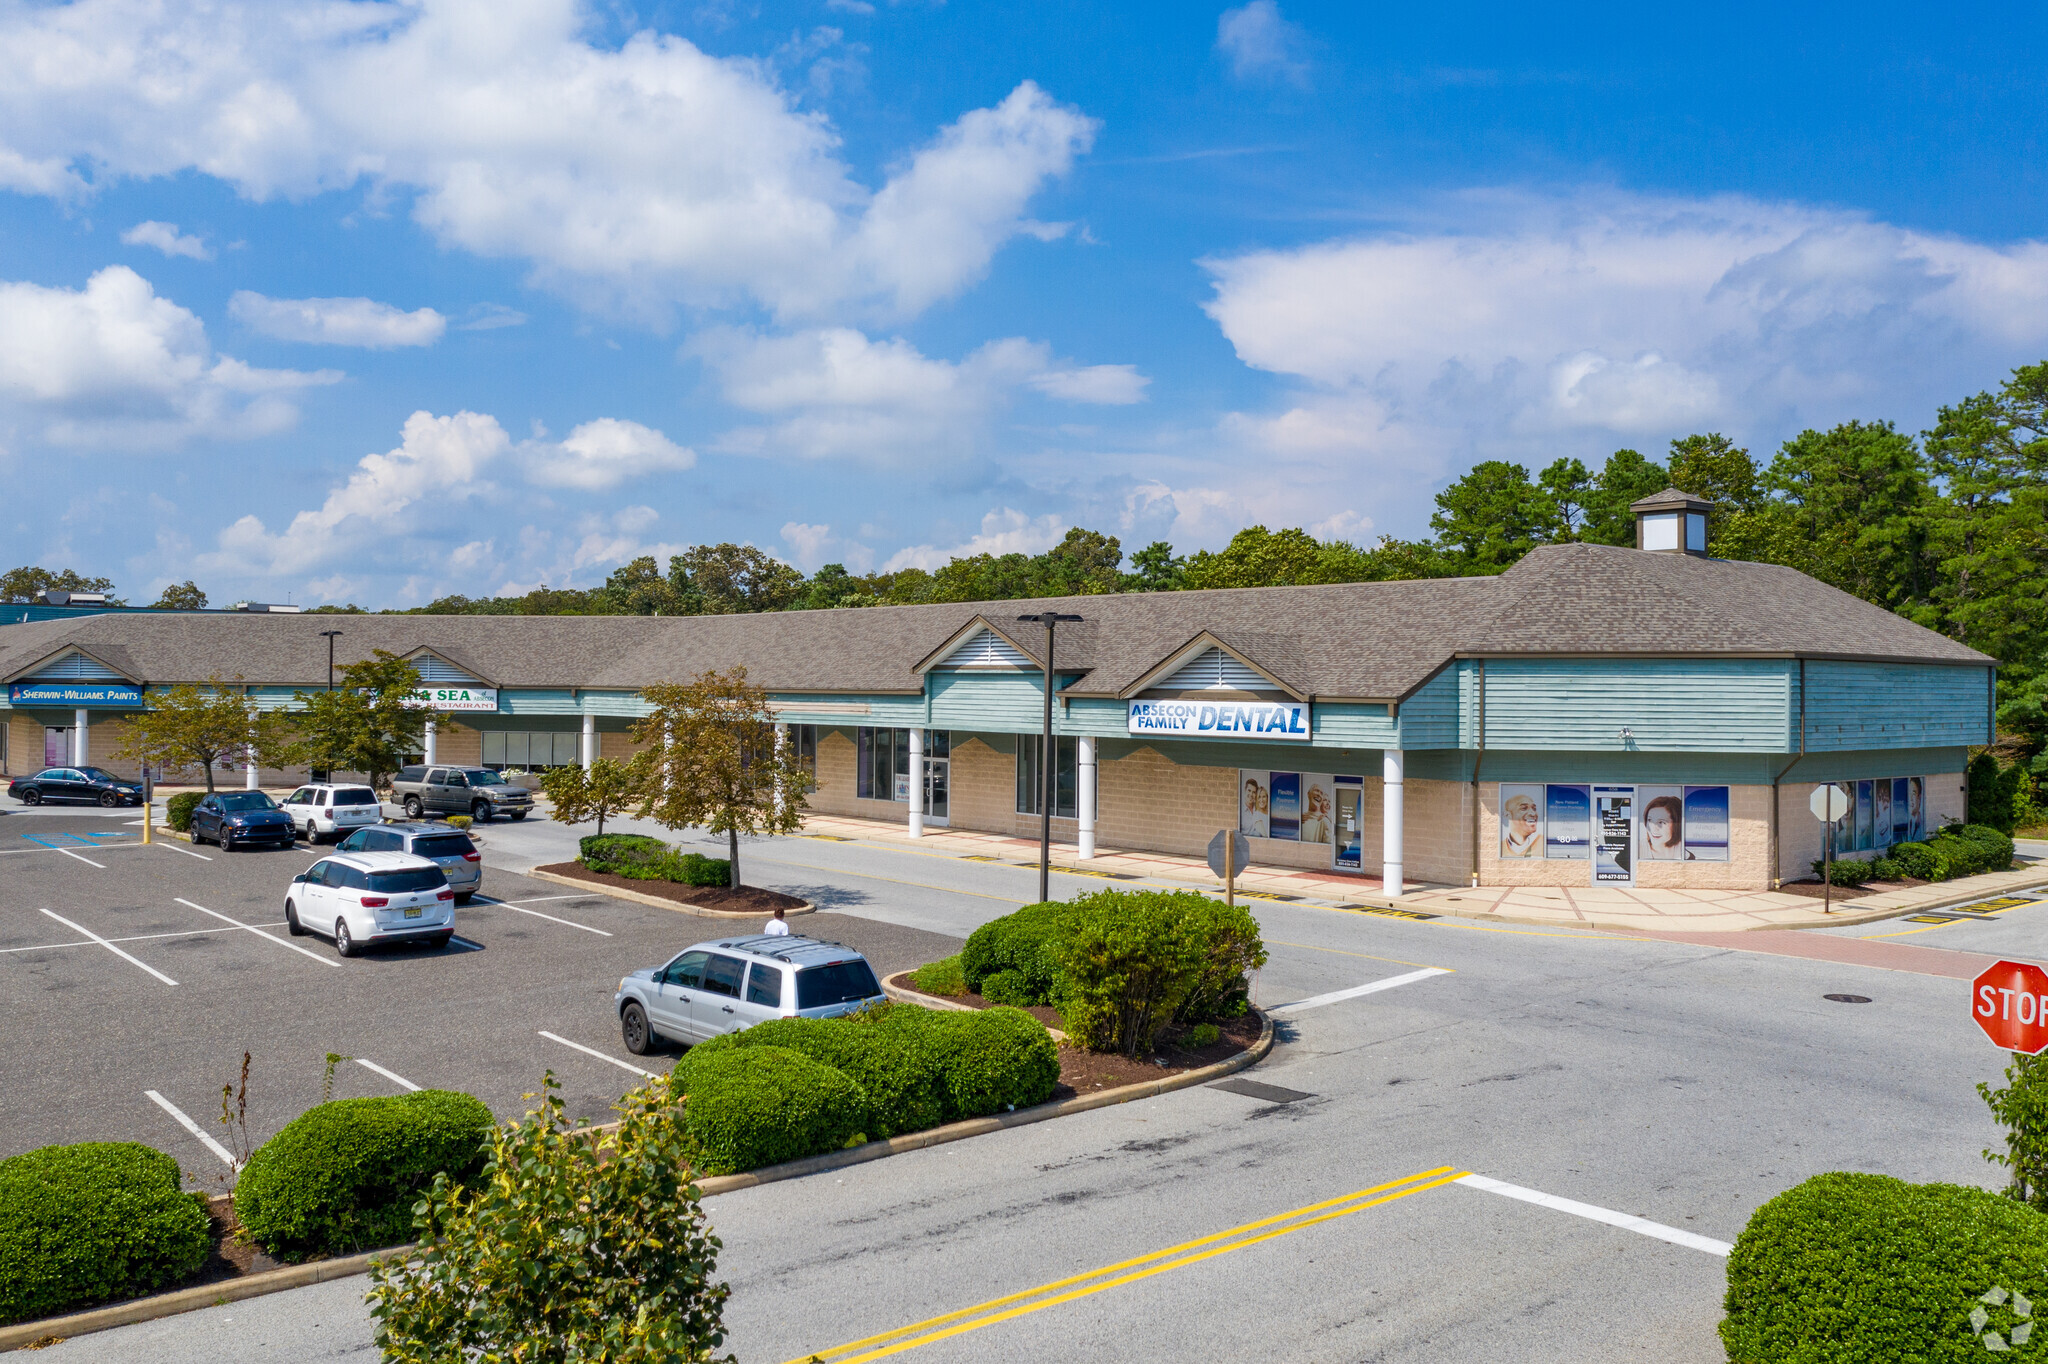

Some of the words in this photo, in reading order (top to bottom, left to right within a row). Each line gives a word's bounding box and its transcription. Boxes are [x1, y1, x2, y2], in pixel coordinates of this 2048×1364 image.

[107, 690, 138, 701] PAINTS
[437, 689, 471, 701] SEA
[1131, 704, 1197, 717] ABSECON
[1137, 716, 1189, 730] FAMILY
[1198, 705, 1306, 734] DENTAL
[1688, 805, 1722, 815] Emergency
